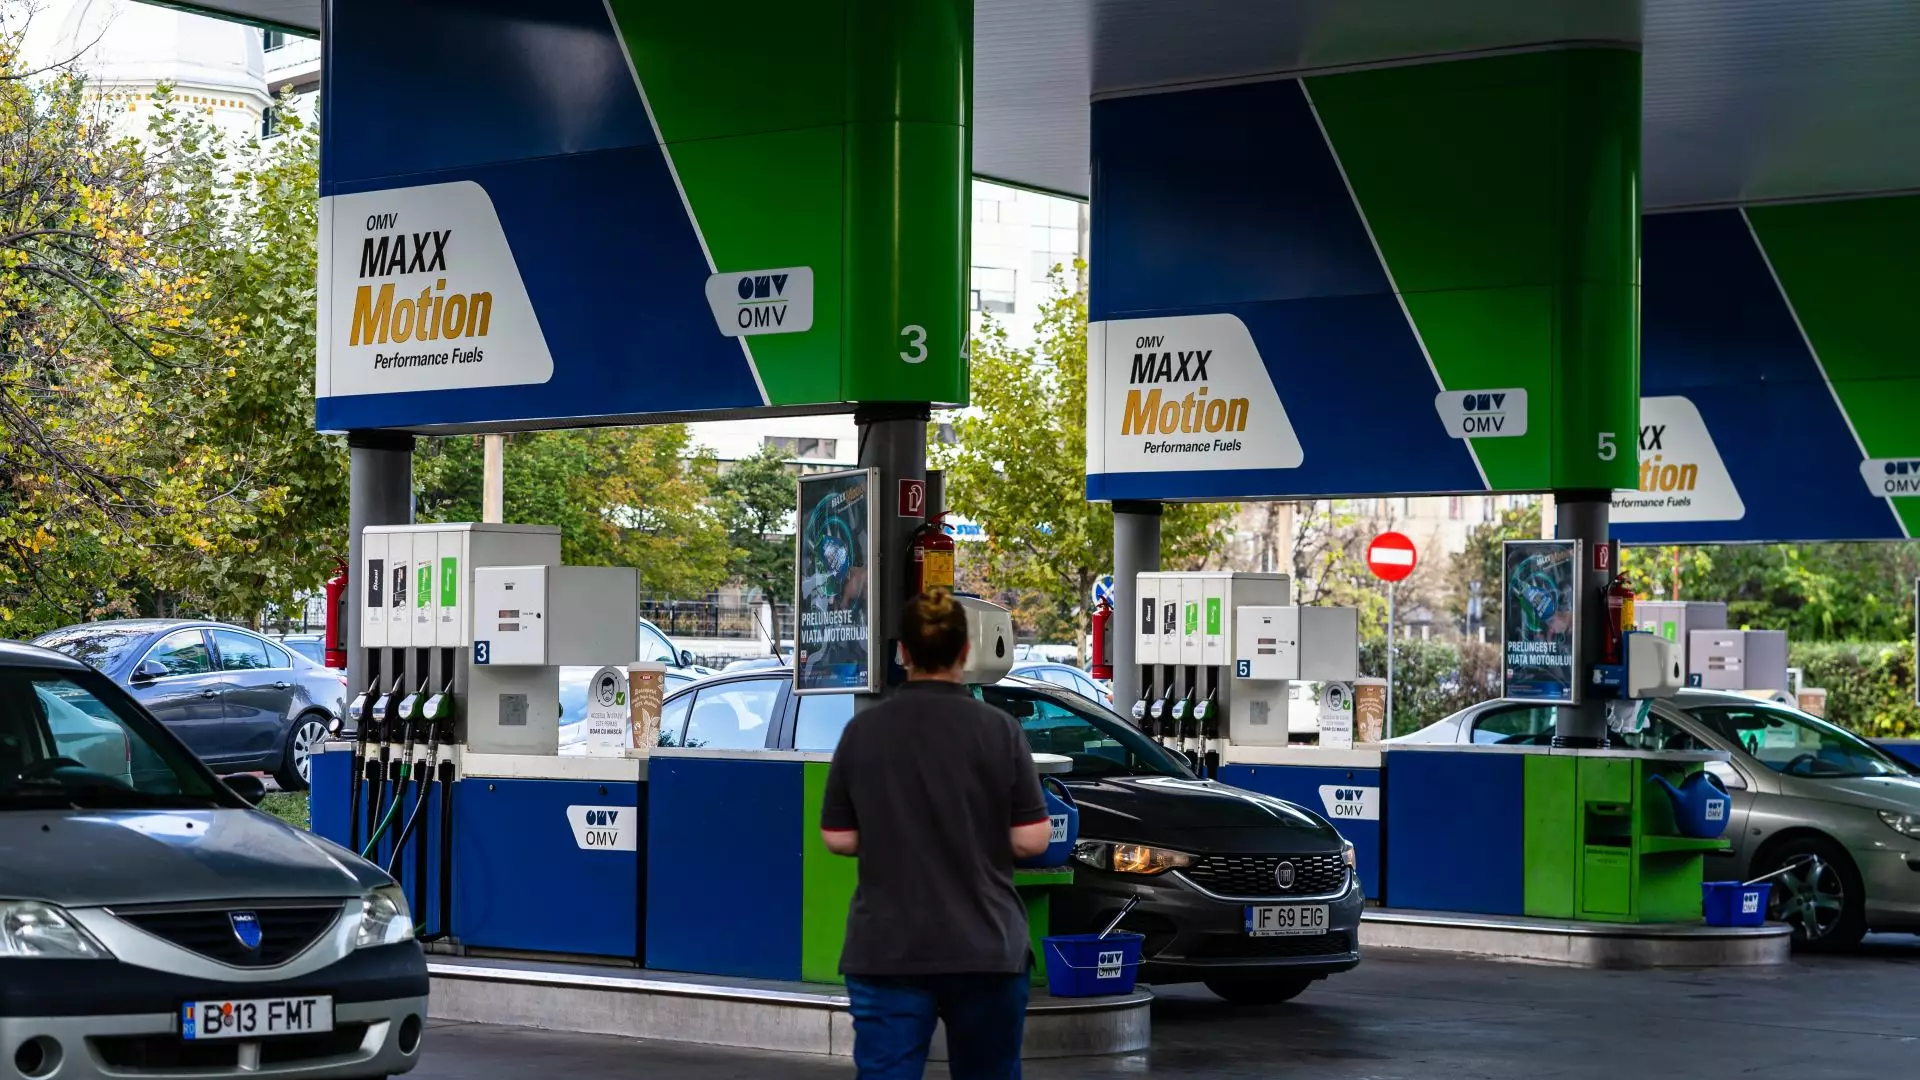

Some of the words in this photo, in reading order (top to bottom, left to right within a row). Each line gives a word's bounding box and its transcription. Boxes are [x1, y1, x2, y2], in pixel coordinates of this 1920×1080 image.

[366, 212, 398, 231] OMV
[359, 230, 452, 278] MAXX
[349, 278, 493, 347] Motion
[738, 305, 787, 329] OMV
[899, 324, 928, 364] 3
[1136, 335, 1165, 349] OMV
[374, 352, 449, 370] Performance
[451, 346, 483, 364] Fuels
[1130, 350, 1212, 384] MAXX
[1121, 386, 1250, 436] Motion
[1462, 416, 1505, 433] OMV
[1144, 440, 1211, 454] Performance
[1213, 438, 1242, 452] Fuels
[1598, 431, 1617, 461] 5
[1639, 425, 1666, 450] XX
[1638, 454, 1698, 492] tion
[1884, 479, 1920, 493] OMV
[1611, 497, 1665, 509] erformance
[1667, 496, 1691, 507] Fuels
[801, 609, 853, 627] PRELUNGEȘTE
[801, 629, 823, 647] VIAȚA
[824, 626, 868, 643] MOTORULUI
[477, 643, 487, 662] 3
[1507, 641, 1557, 654] PRELUNGEȘTE
[1239, 661, 1248, 676] 5
[1507, 654, 1528, 667] VIAȚA
[1529, 655, 1572, 666] MOTORULUI
[1692, 675, 1700, 686] 7
[1335, 804, 1363, 816] OMV
[1707, 810, 1721, 818] OMV
[586, 831, 618, 846] OMV
[1050, 830, 1065, 840] MV
[1259, 908, 1273, 928] IF
[1278, 908, 1295, 927] 69
[1300, 907, 1323, 927] EIG
[203, 1004, 223, 1034] B
[234, 1003, 257, 1032] 13
[268, 999, 316, 1031] FMT
[183, 1023, 194, 1034] RO
